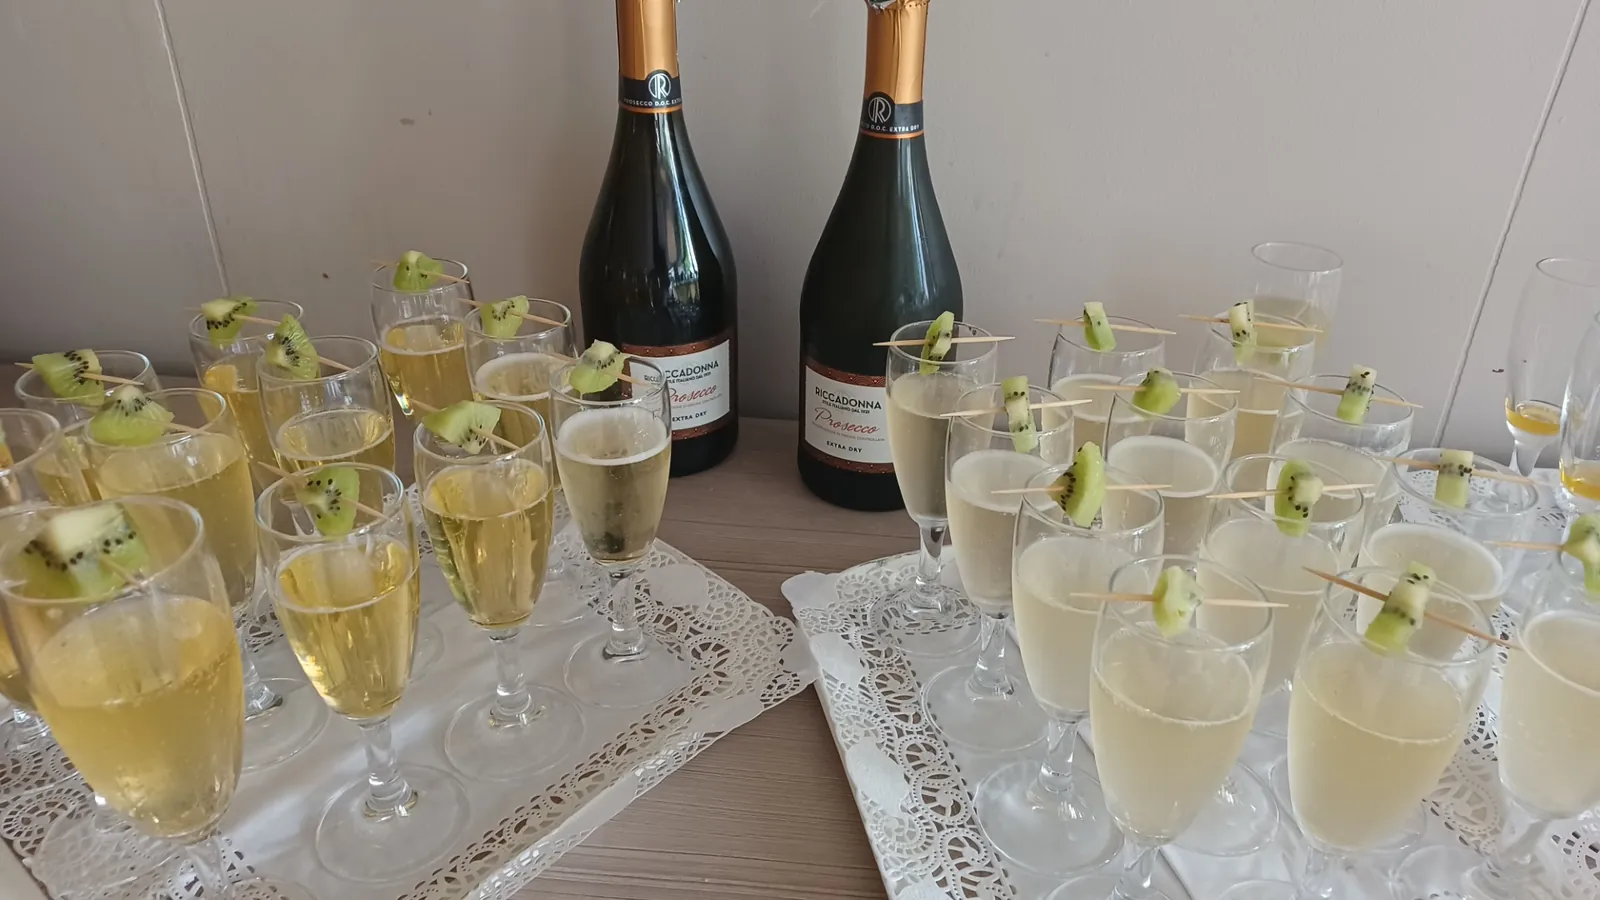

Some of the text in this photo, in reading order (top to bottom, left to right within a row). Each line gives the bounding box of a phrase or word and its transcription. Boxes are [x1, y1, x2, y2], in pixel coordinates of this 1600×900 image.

[623, 97, 653, 106] PROSECCO
[664, 360, 719, 379] CCADONNA
[815, 386, 882, 410] RICCADONNA
[672, 410, 707, 422] EXTRA DRY
[814, 407, 880, 434] Prosecco
[826, 440, 846, 450] EXTRA
